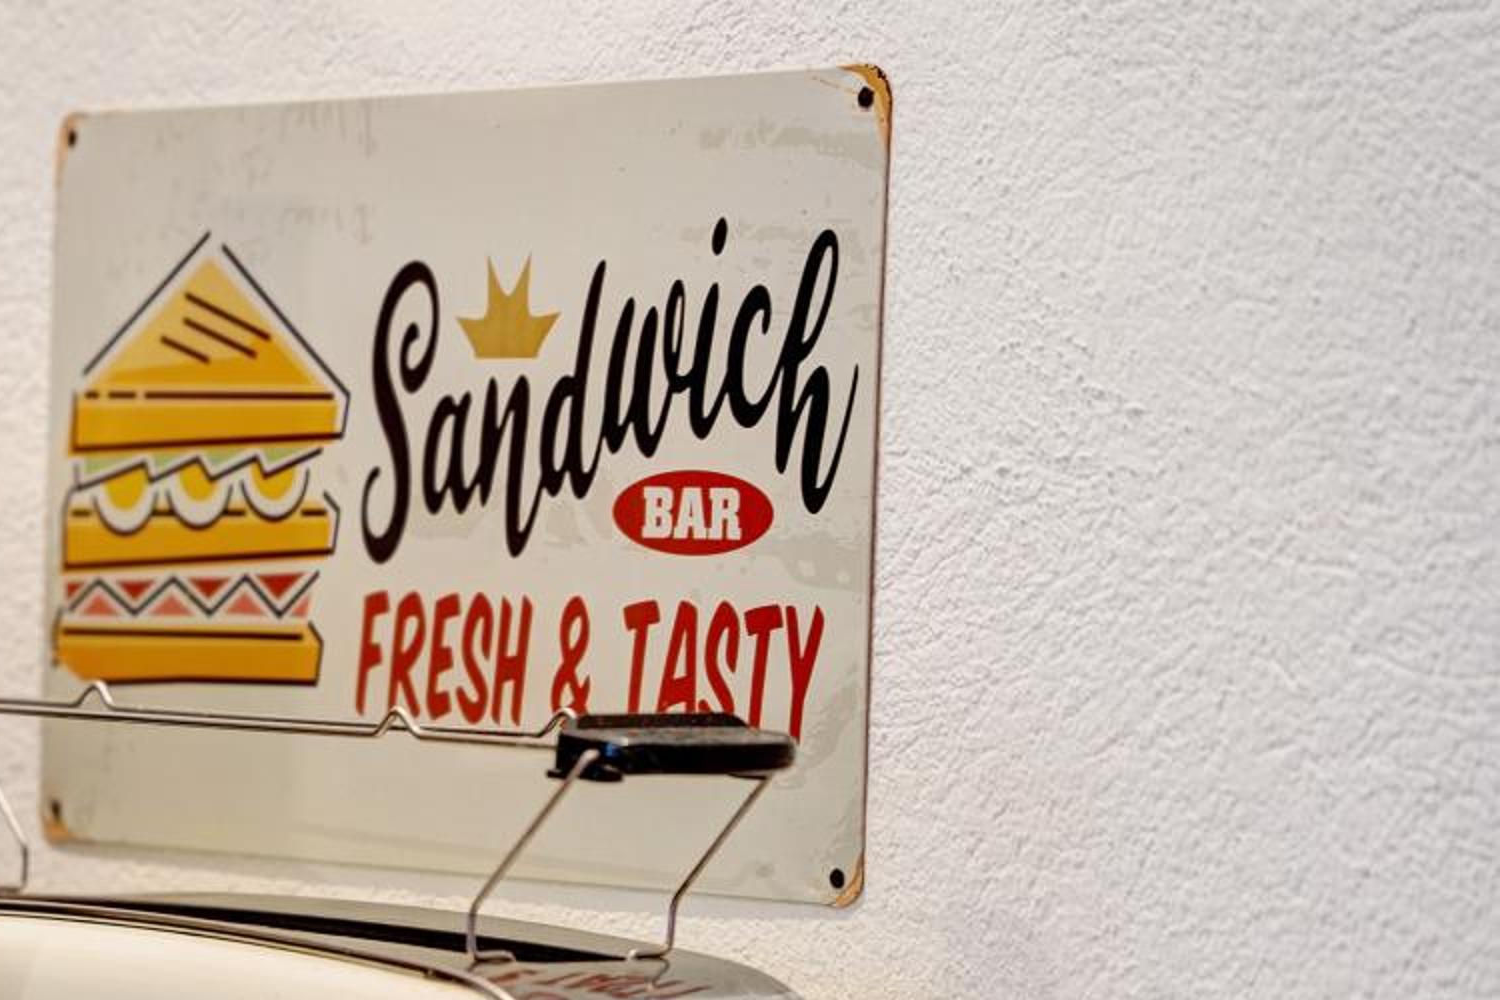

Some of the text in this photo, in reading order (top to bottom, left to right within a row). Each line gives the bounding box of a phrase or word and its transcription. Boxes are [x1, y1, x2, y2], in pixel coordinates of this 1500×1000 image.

[361, 217, 858, 563] Sandwich
[641, 484, 743, 541] BAR
[355, 590, 825, 743] FRESH & TASTY
